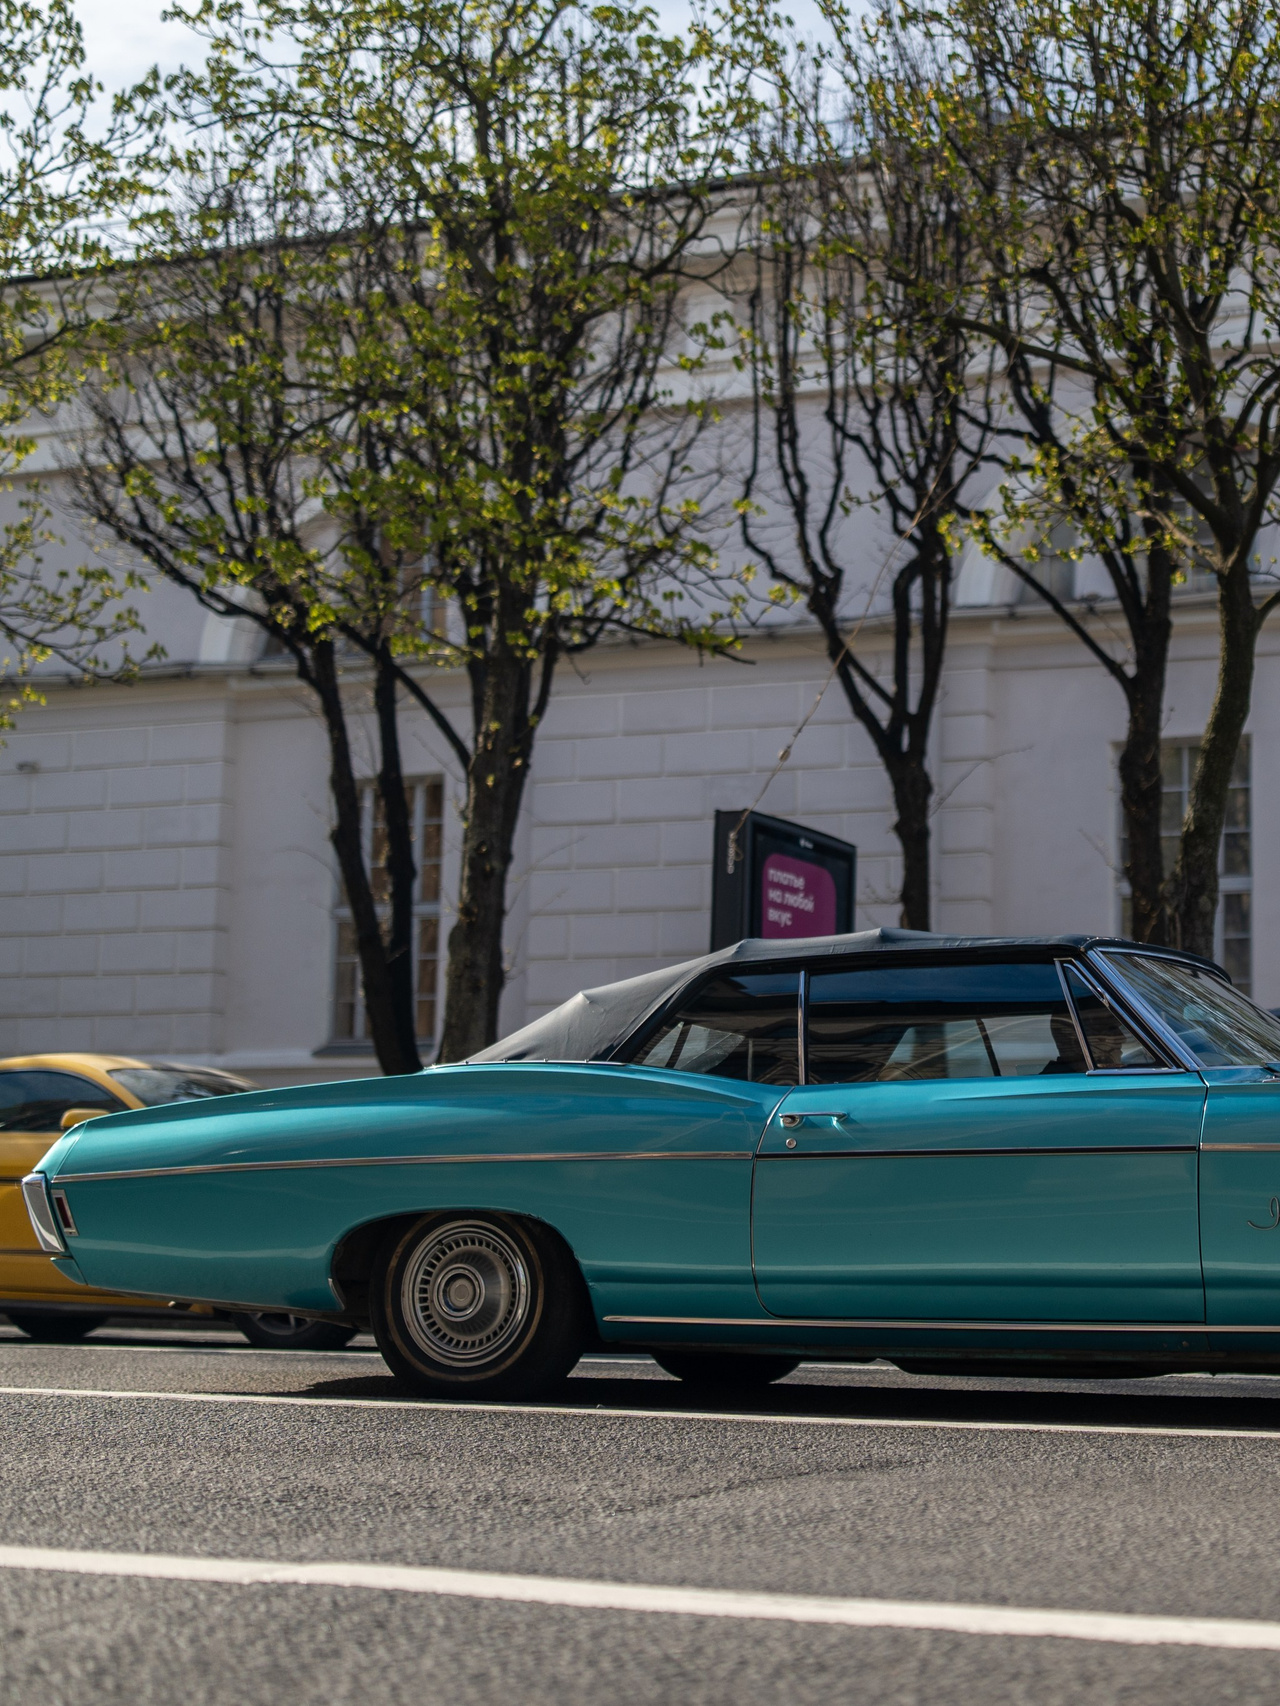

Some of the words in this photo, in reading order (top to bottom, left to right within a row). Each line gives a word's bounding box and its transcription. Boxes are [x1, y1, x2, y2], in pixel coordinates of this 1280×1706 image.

[768, 889, 783, 904] на
[783, 891, 815, 913] любой
[767, 908, 793, 928] вкус
